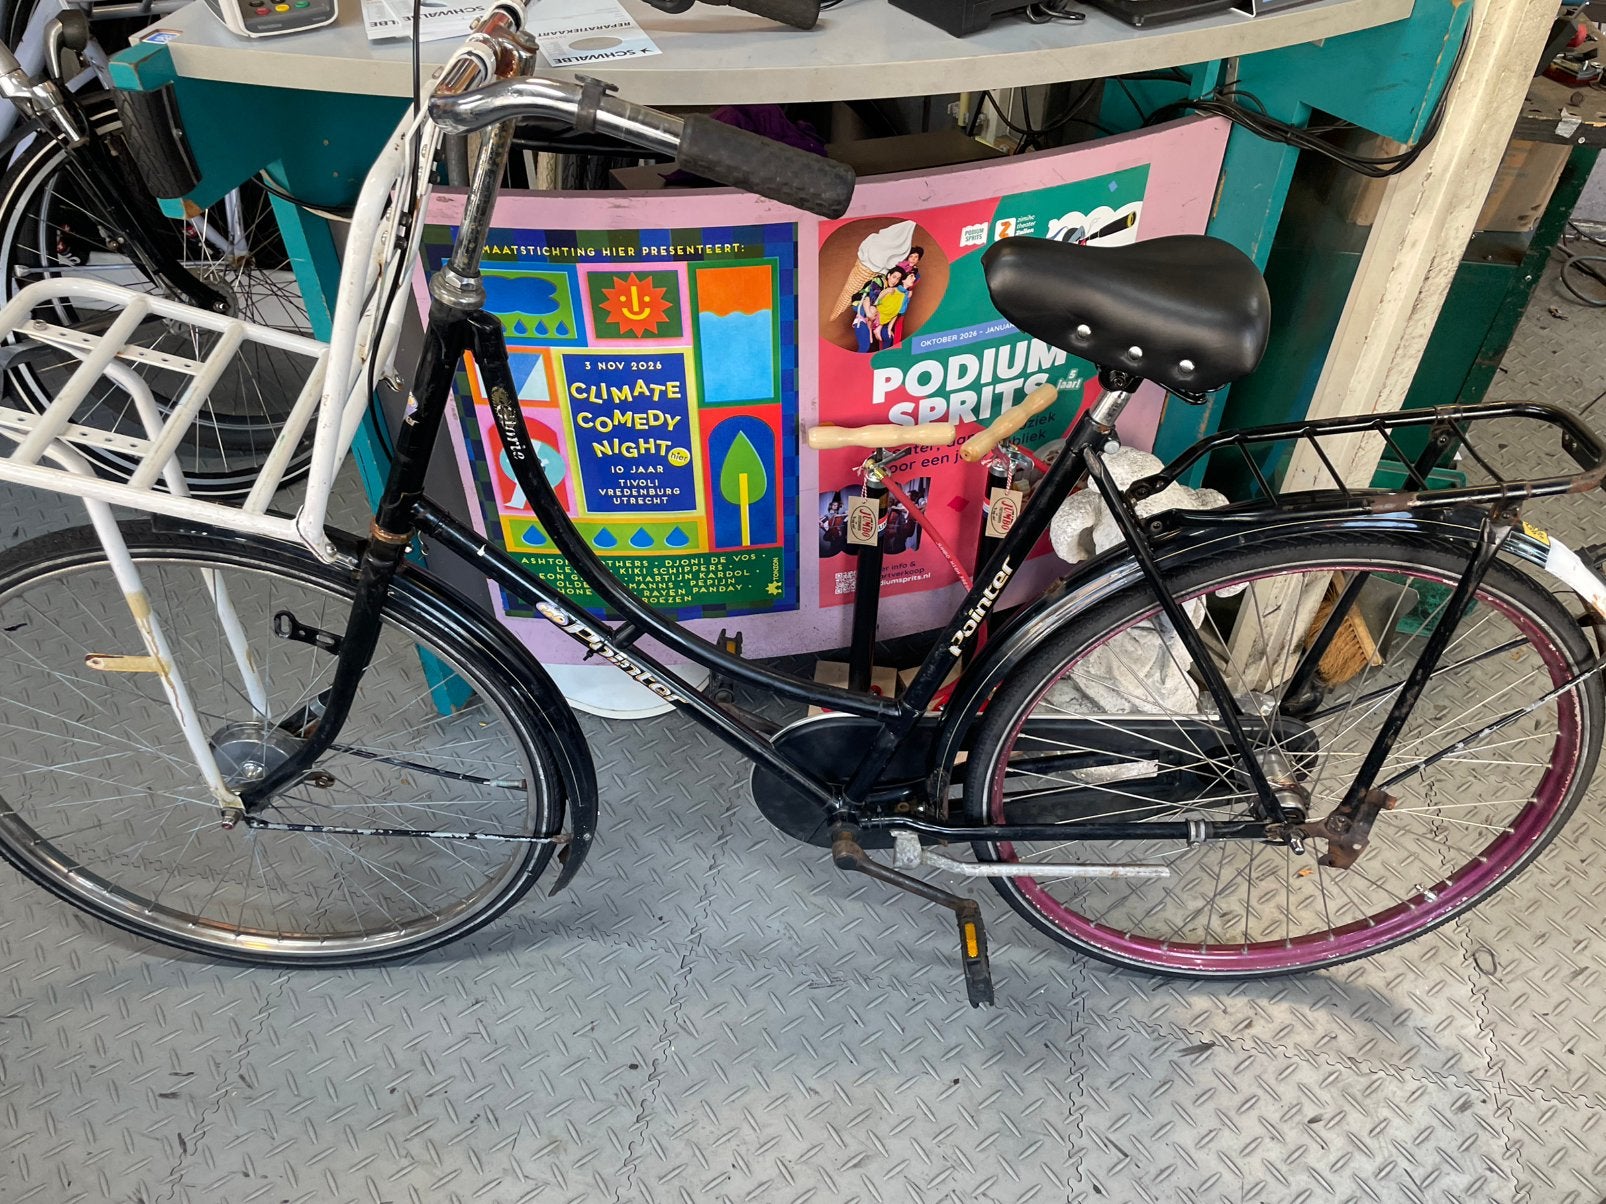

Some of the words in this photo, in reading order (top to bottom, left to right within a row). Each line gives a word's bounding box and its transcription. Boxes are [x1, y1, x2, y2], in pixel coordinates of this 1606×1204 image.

[403, 5, 486, 23] SCHWALE
[537, 21, 632, 38] REPARATIEKAART
[553, 50, 637, 65] SCHWALBE
[965, 234, 983, 242] SPRITS
[482, 244, 596, 257] MAATSTICHTING
[602, 246, 635, 257] HIER
[642, 243, 745, 256] PRESENTEERT:
[920, 334, 958, 347] OKTOBER
[959, 330, 977, 340] 2026
[985, 323, 1015, 334] JANUAR
[584, 361, 592, 370] 3
[598, 361, 625, 370] NOV
[631, 361, 662, 370] 2026
[872, 338, 1067, 404] PODIUM
[570, 379, 681, 404] CLIMATE
[576, 409, 682, 433] COMEDY
[592, 438, 672, 458] NIGHT
[889, 461, 918, 474] oor
[921, 455, 950, 468] een
[1008, 429, 1046, 446] bliek
[670, 452, 688, 462] hier
[630, 465, 664, 473] JAAR
[618, 479, 659, 487] TIVOLI
[599, 488, 681, 496] VREDENBURG
[613, 497, 668, 505] UTRECHT
[1001, 499, 1014, 531] JUMBO
[860, 507, 872, 538] JUMBO
[665, 557, 704, 567] DJONI
[711, 556, 727, 564] DE
[733, 553, 756, 562] VOS
[891, 562, 908, 570] info
[620, 567, 646, 575] KIKI
[653, 564, 723, 575] SCHIPPERS
[635, 573, 692, 582] MARTIJN
[700, 569, 750, 578] KARDOL
[880, 567, 925, 579] artverkoop
[629, 582, 674, 590] MANNS
[690, 578, 736, 587] PEPIJN
[880, 572, 931, 586] diumsprits.nl
[643, 588, 686, 597] RAYEN
[692, 584, 742, 594] PANDAY
[949, 554, 1014, 657] Pointer
[562, 622, 689, 704] Pointer
